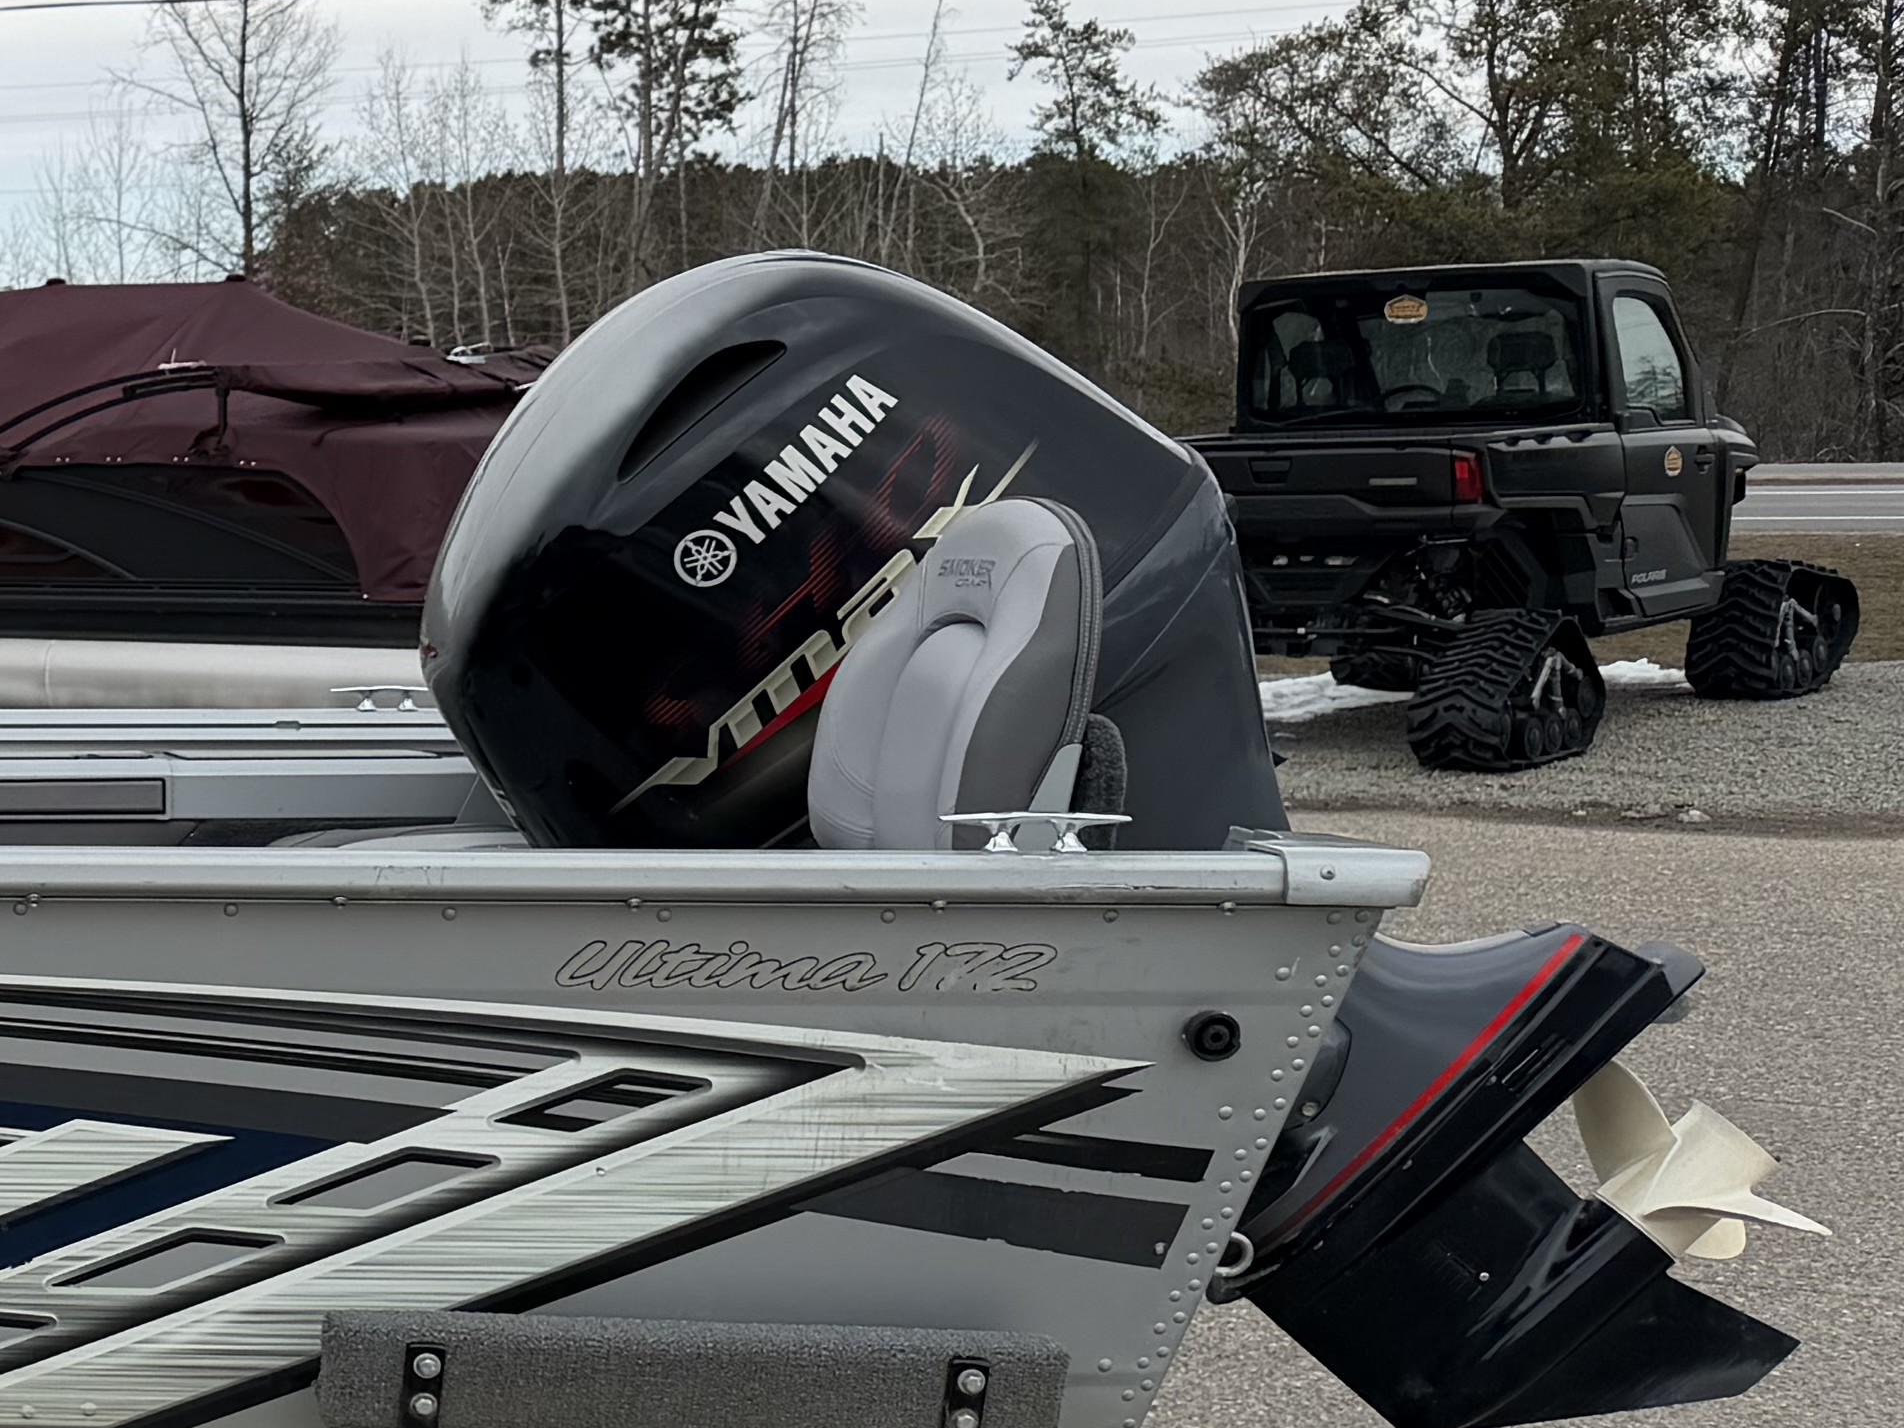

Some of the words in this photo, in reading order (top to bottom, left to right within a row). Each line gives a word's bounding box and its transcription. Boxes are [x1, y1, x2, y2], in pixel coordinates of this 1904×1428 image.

[712, 373, 899, 544] YAMAHA
[554, 939, 888, 992] Ultima
[897, 941, 1058, 993] 172
